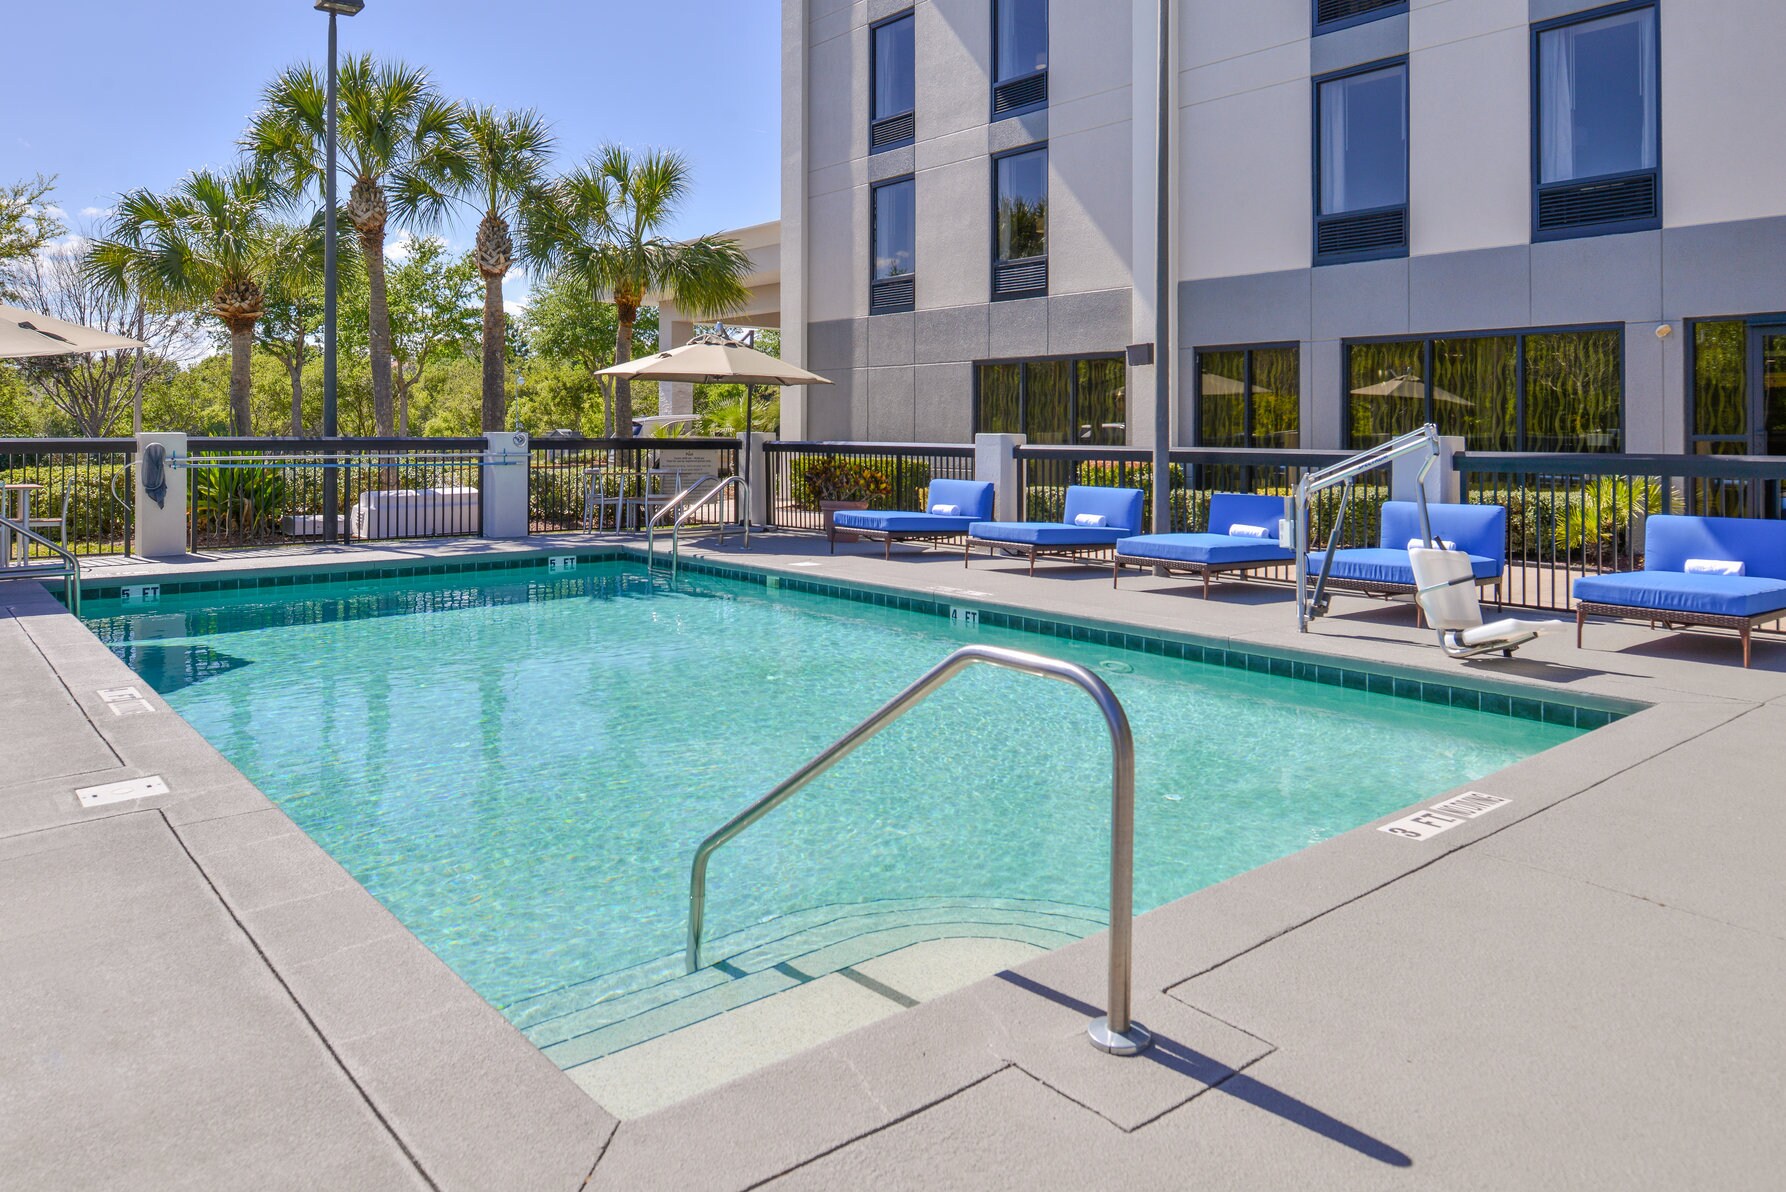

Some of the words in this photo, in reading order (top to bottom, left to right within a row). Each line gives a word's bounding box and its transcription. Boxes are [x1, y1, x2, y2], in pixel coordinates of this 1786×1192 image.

[563, 557, 575, 567] FT
[121, 588, 130, 598] 5
[142, 586, 159, 598] FT
[951, 608, 958, 620] 4
[965, 610, 977, 622] FT
[1388, 827, 1422, 838] 3
[1410, 813, 1456, 828] FT
